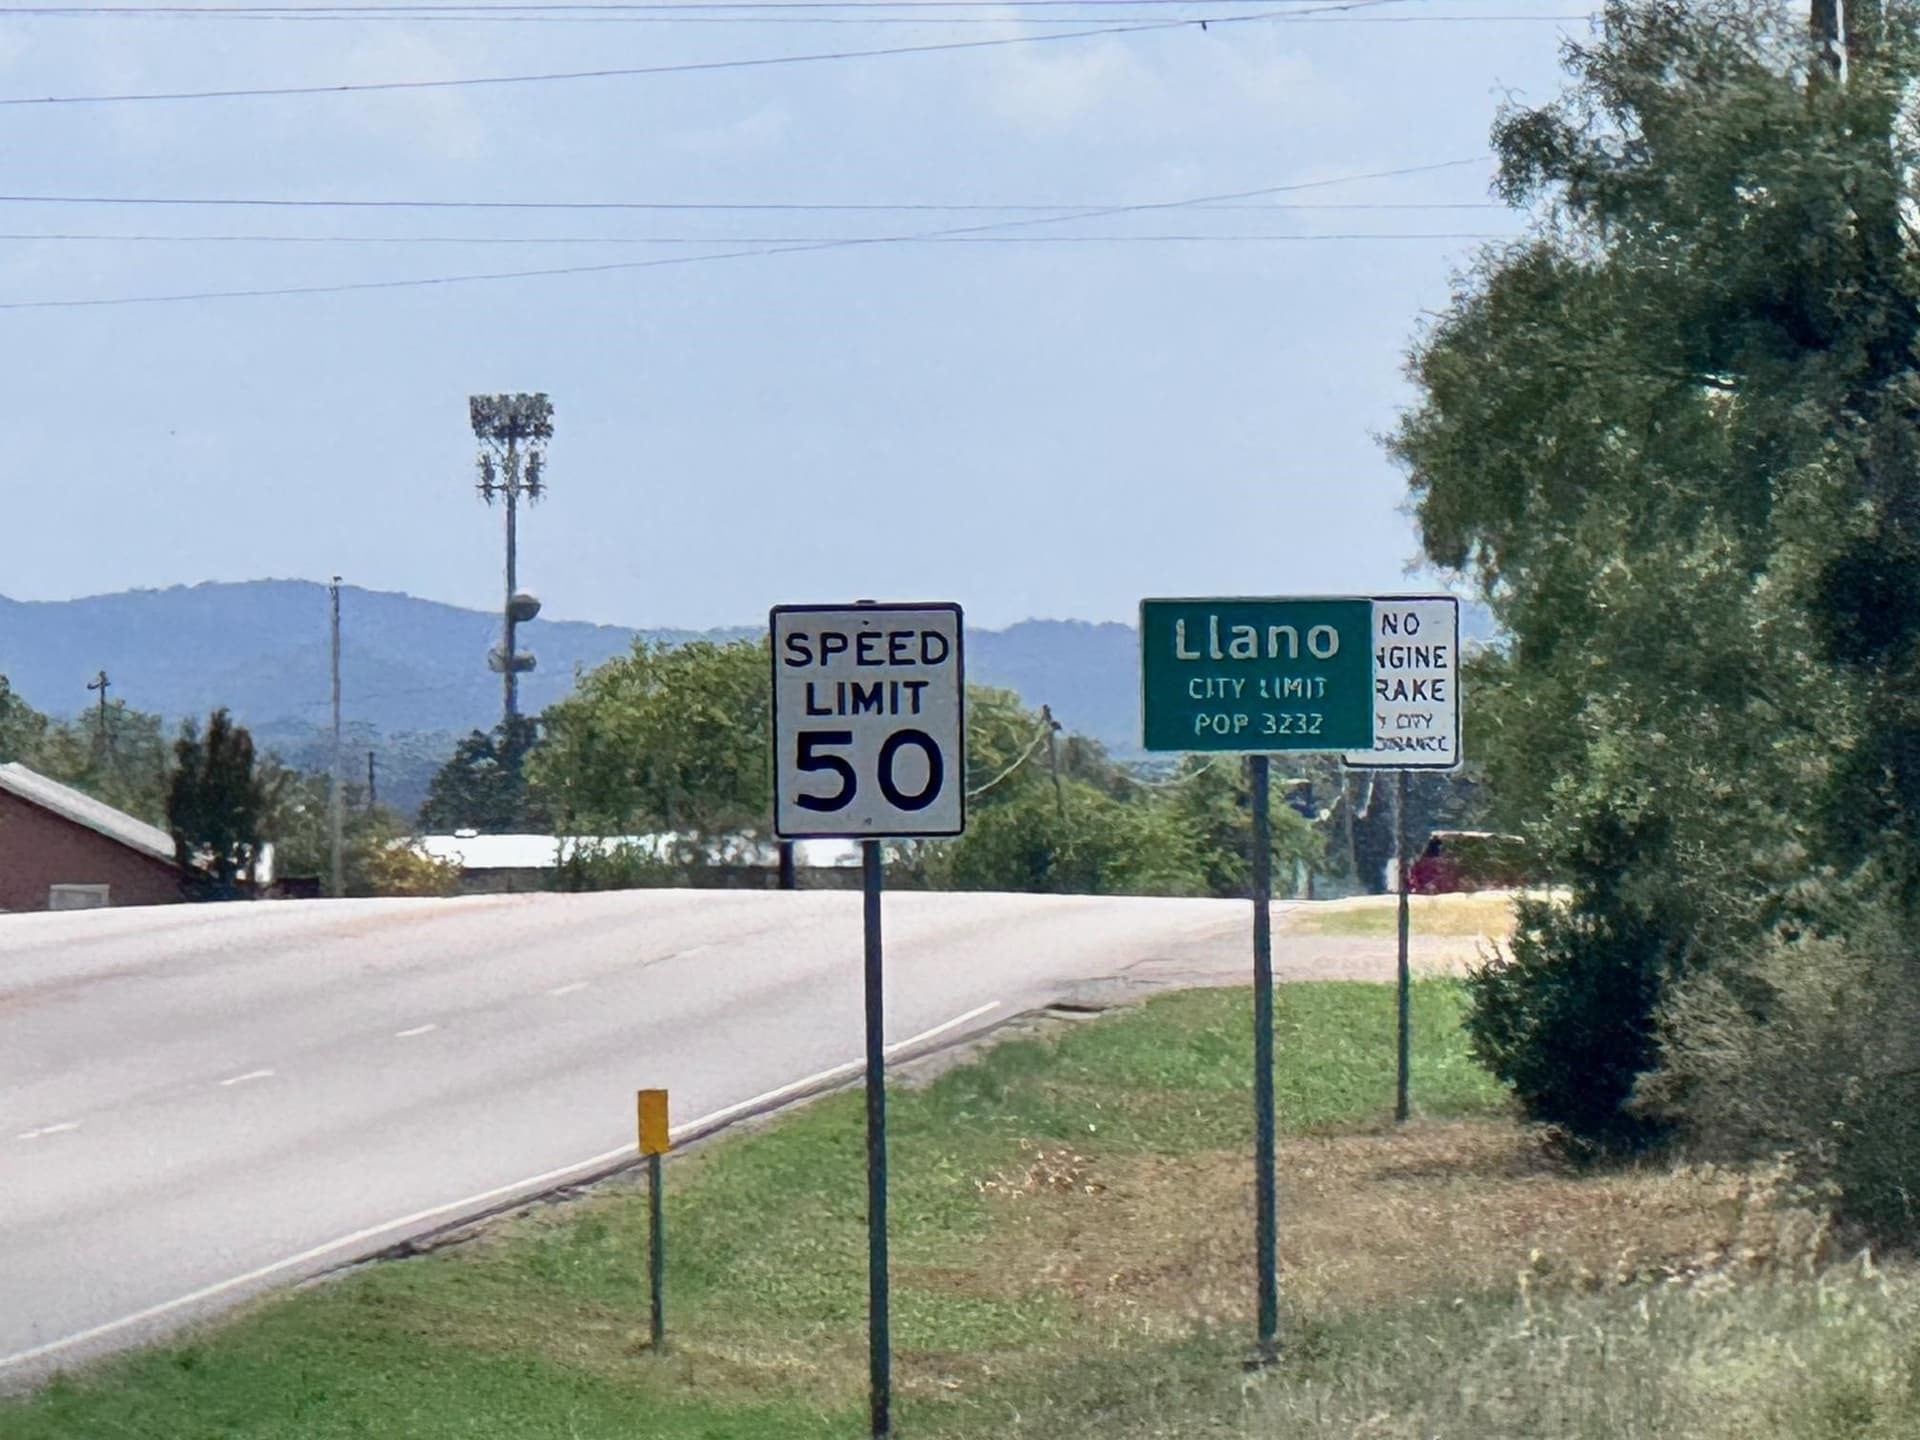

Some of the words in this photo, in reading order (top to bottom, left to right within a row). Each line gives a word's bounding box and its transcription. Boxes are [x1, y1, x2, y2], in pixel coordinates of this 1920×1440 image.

[1381, 612, 1420, 636] NO
[785, 630, 949, 667] SPEED
[1175, 614, 1340, 661] Llano
[1376, 645, 1448, 669] NGINE
[806, 680, 930, 715] LIMIT
[1188, 677, 1245, 699] CITY
[1259, 677, 1328, 700] LIMIT
[1376, 678, 1446, 702] RAKE
[1194, 712, 1249, 736] POP
[1262, 712, 1324, 735] 3232
[796, 728, 944, 812] 50
